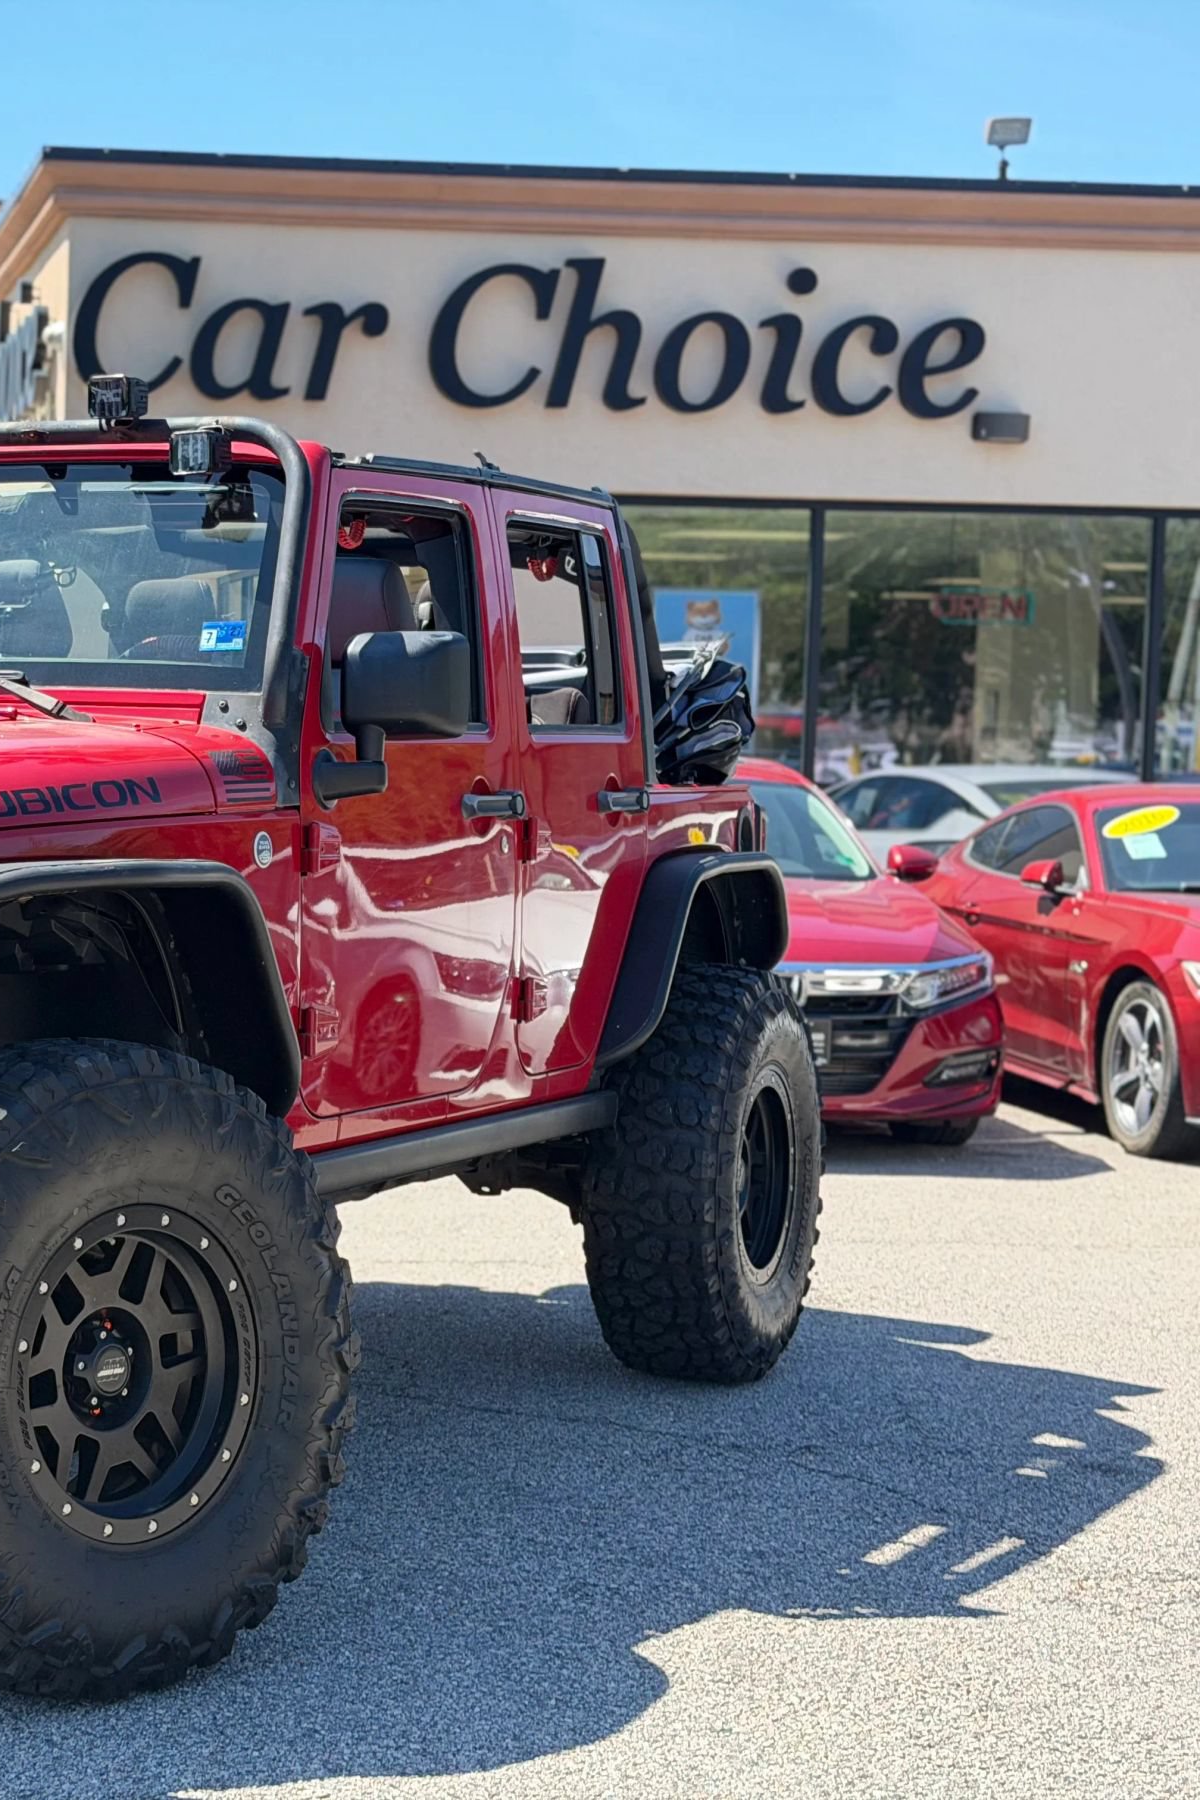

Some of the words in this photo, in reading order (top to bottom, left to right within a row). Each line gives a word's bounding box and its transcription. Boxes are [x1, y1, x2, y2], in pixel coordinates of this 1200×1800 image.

[73, 252, 389, 402] Car
[428, 258, 986, 418] Choice
[930, 593, 1025, 619] OPEN
[214, 1183, 300, 1427] GEOLANDAR
